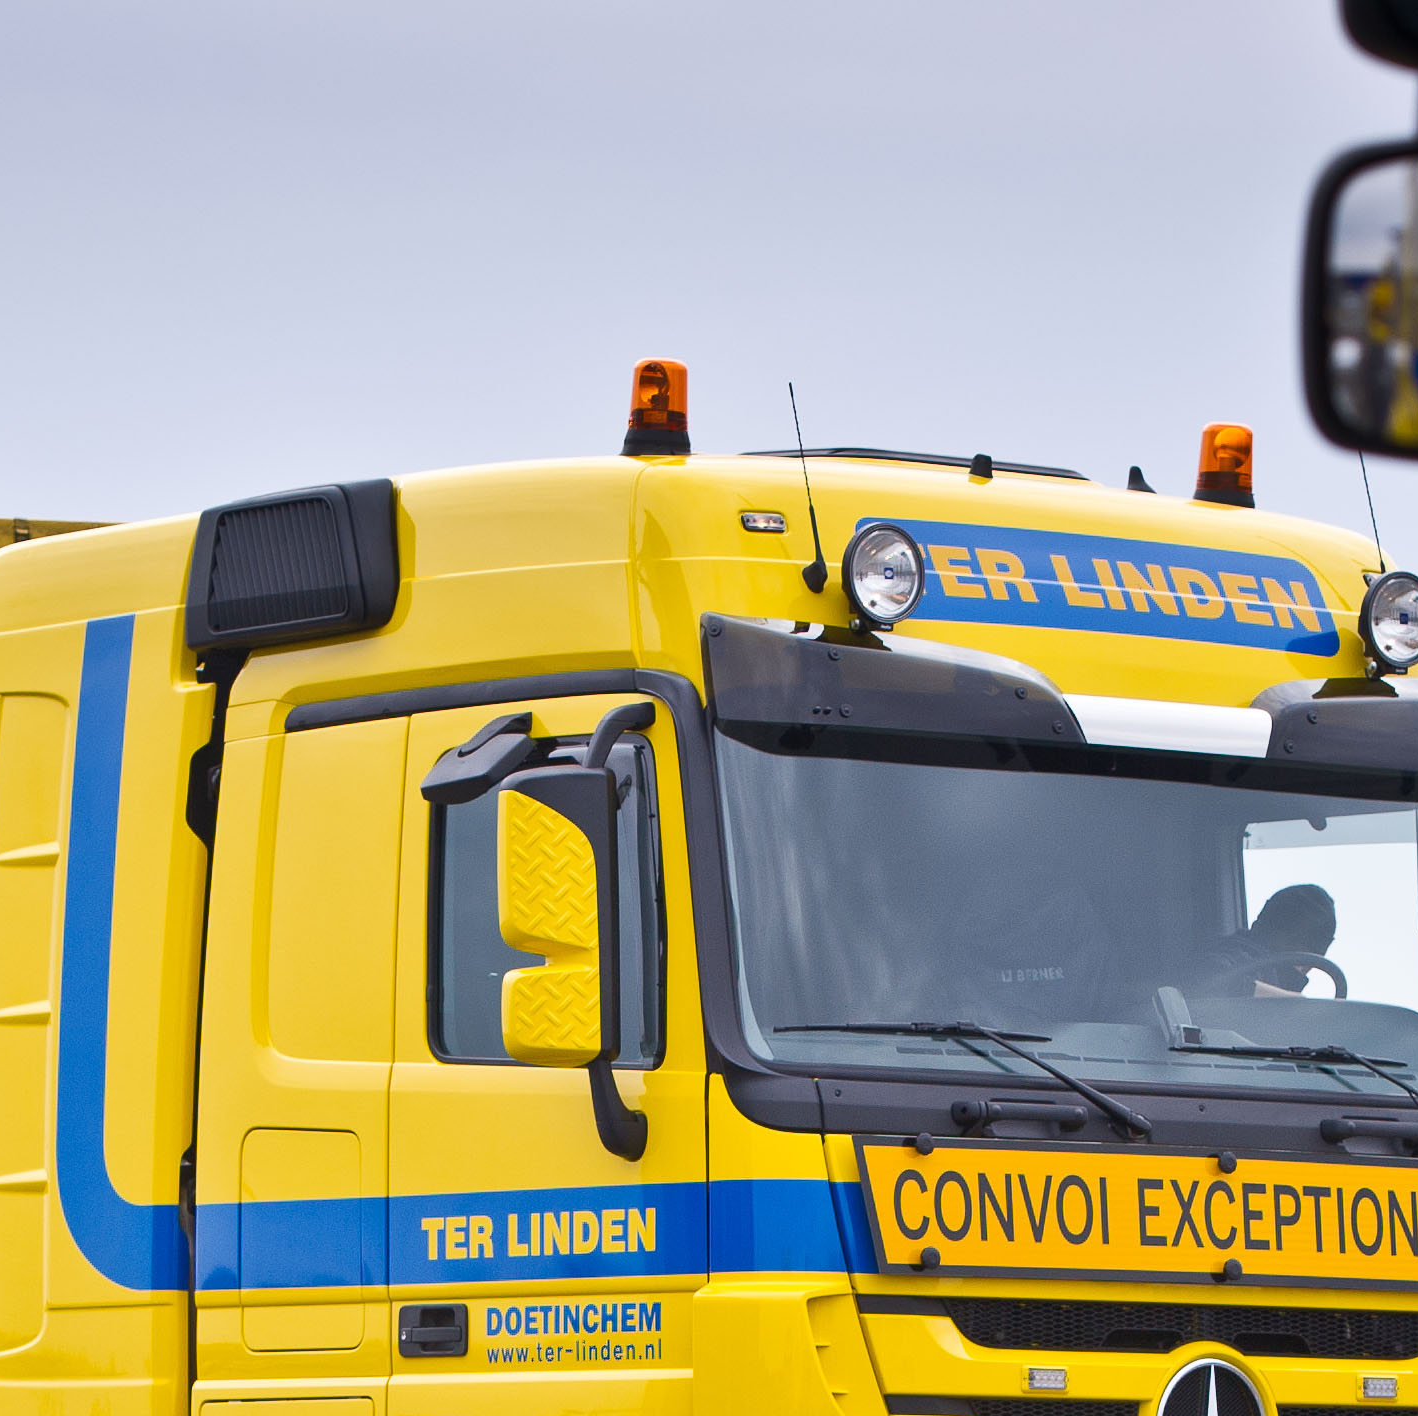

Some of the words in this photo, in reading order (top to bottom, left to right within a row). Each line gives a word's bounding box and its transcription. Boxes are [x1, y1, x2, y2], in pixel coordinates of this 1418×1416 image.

[919, 543, 1040, 604] ER
[1048, 554, 1323, 633] LINDEN
[892, 1167, 1110, 1246] CONVOI
[421, 1215, 493, 1261] TER
[507, 1208, 657, 1257] LINDEN
[485, 1301, 662, 1337] DOETINCHEM
[486, 1339, 662, 1365] www.ter-linden.nl
